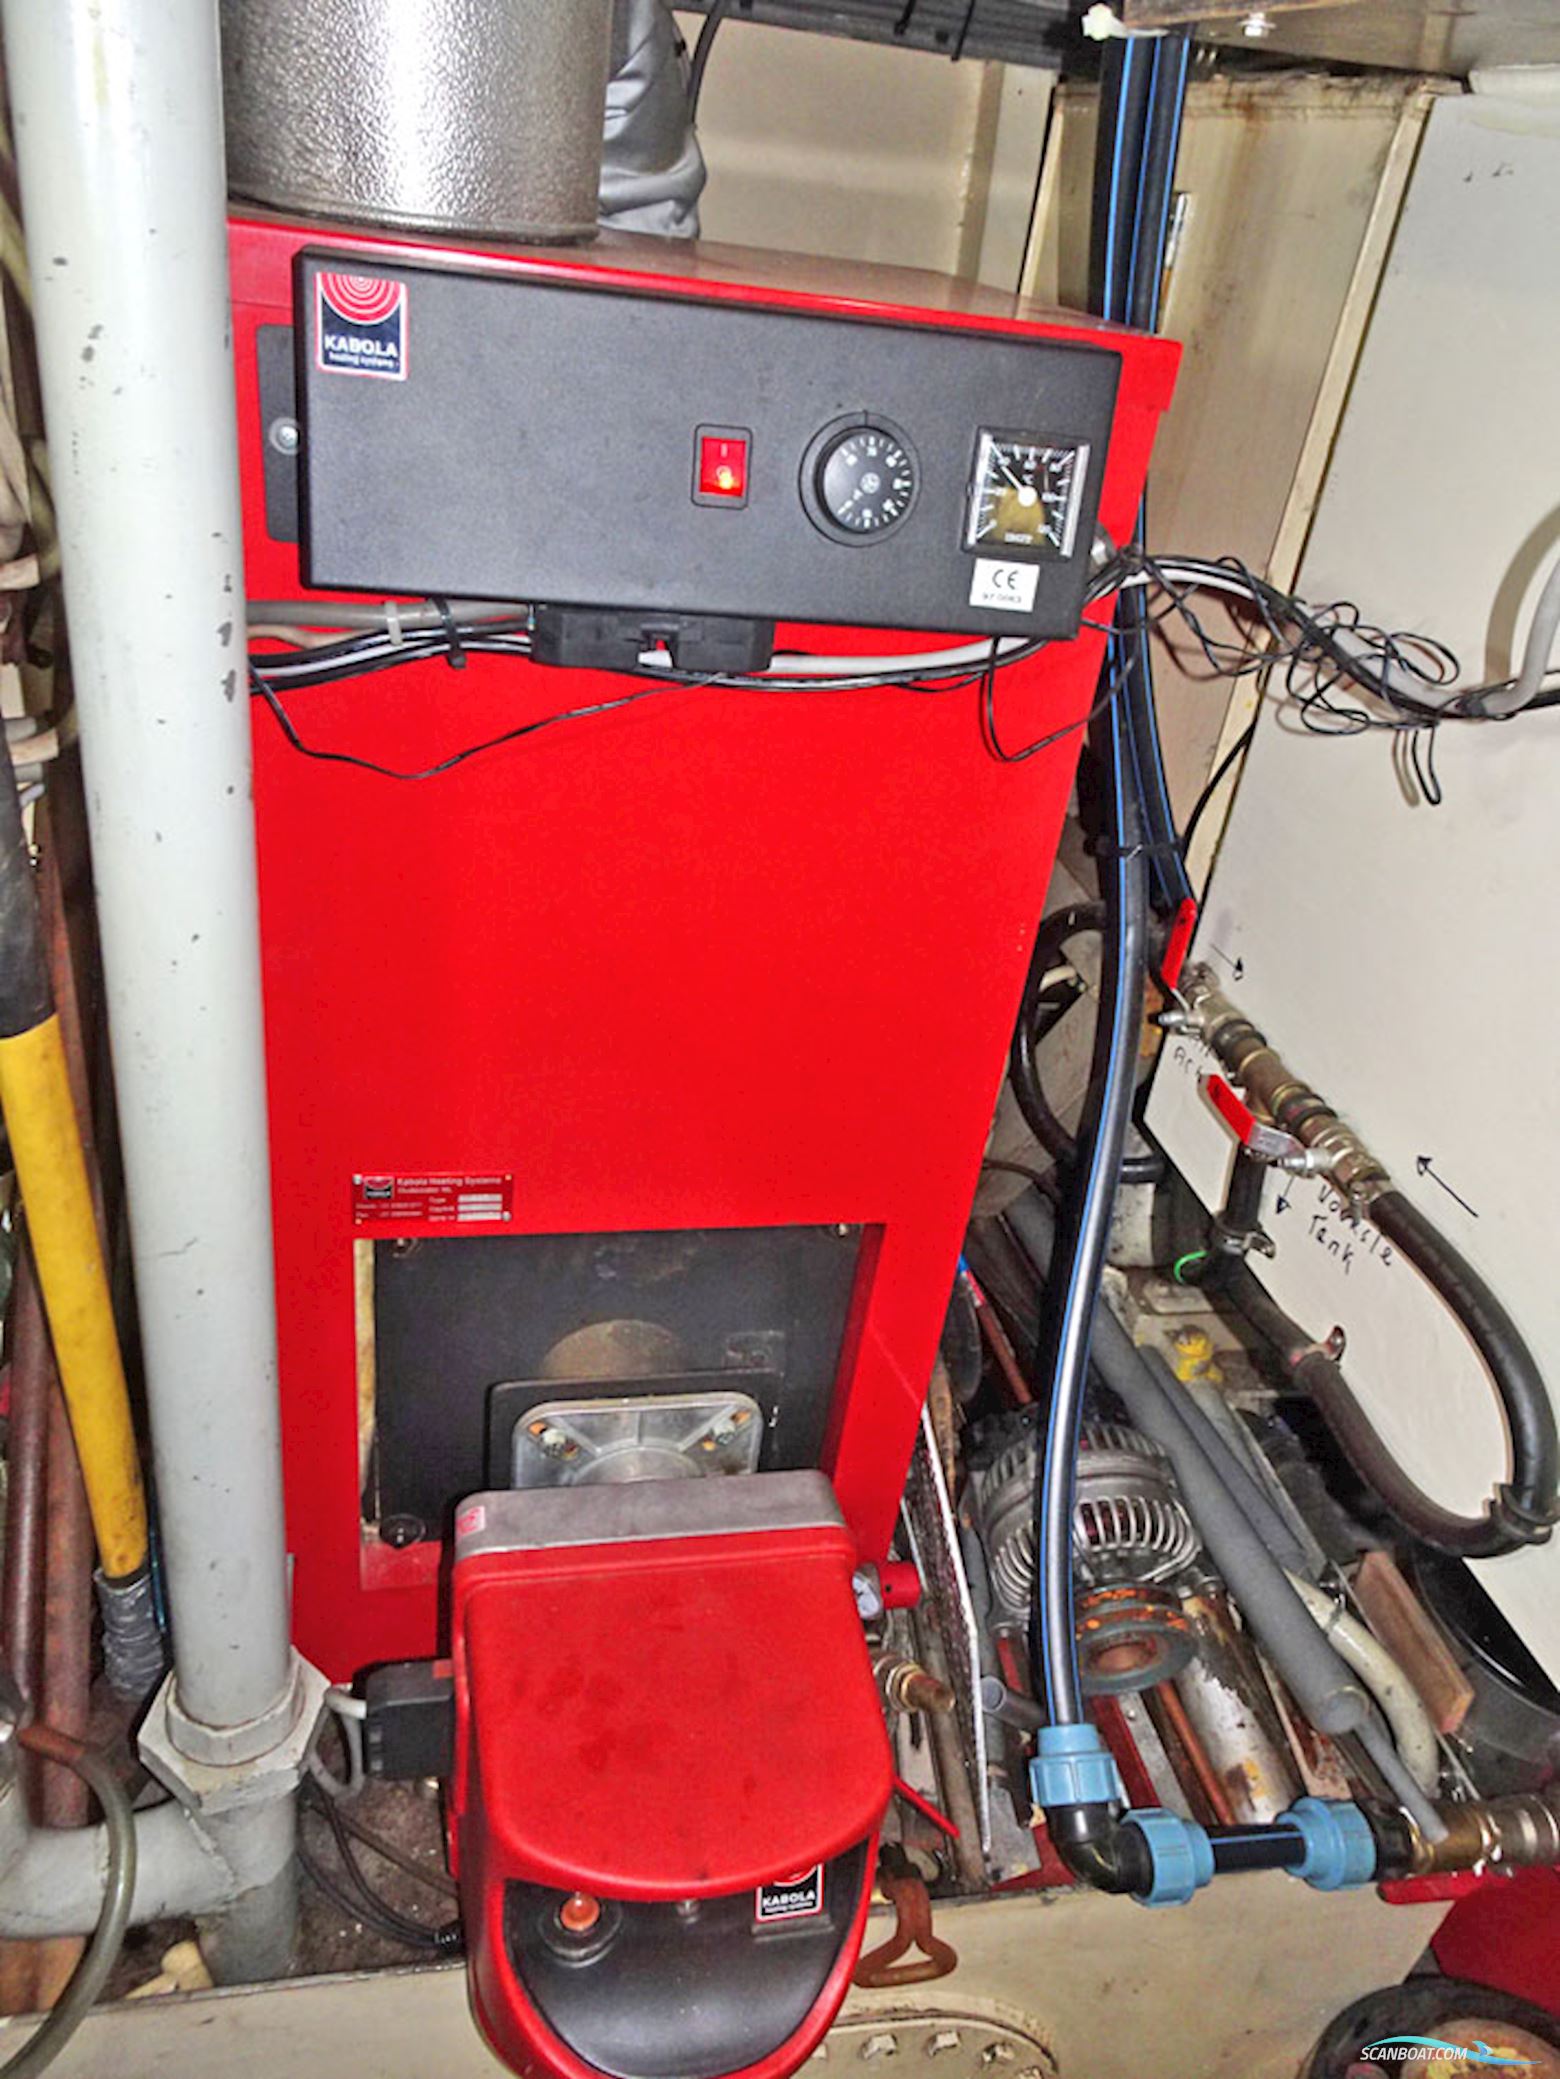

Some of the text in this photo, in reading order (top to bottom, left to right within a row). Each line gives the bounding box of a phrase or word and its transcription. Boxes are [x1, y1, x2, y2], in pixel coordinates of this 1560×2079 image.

[324, 334, 398, 358] KABOLA
[992, 569, 1019, 590] CE
[763, 1890, 816, 1907] KABOLA
